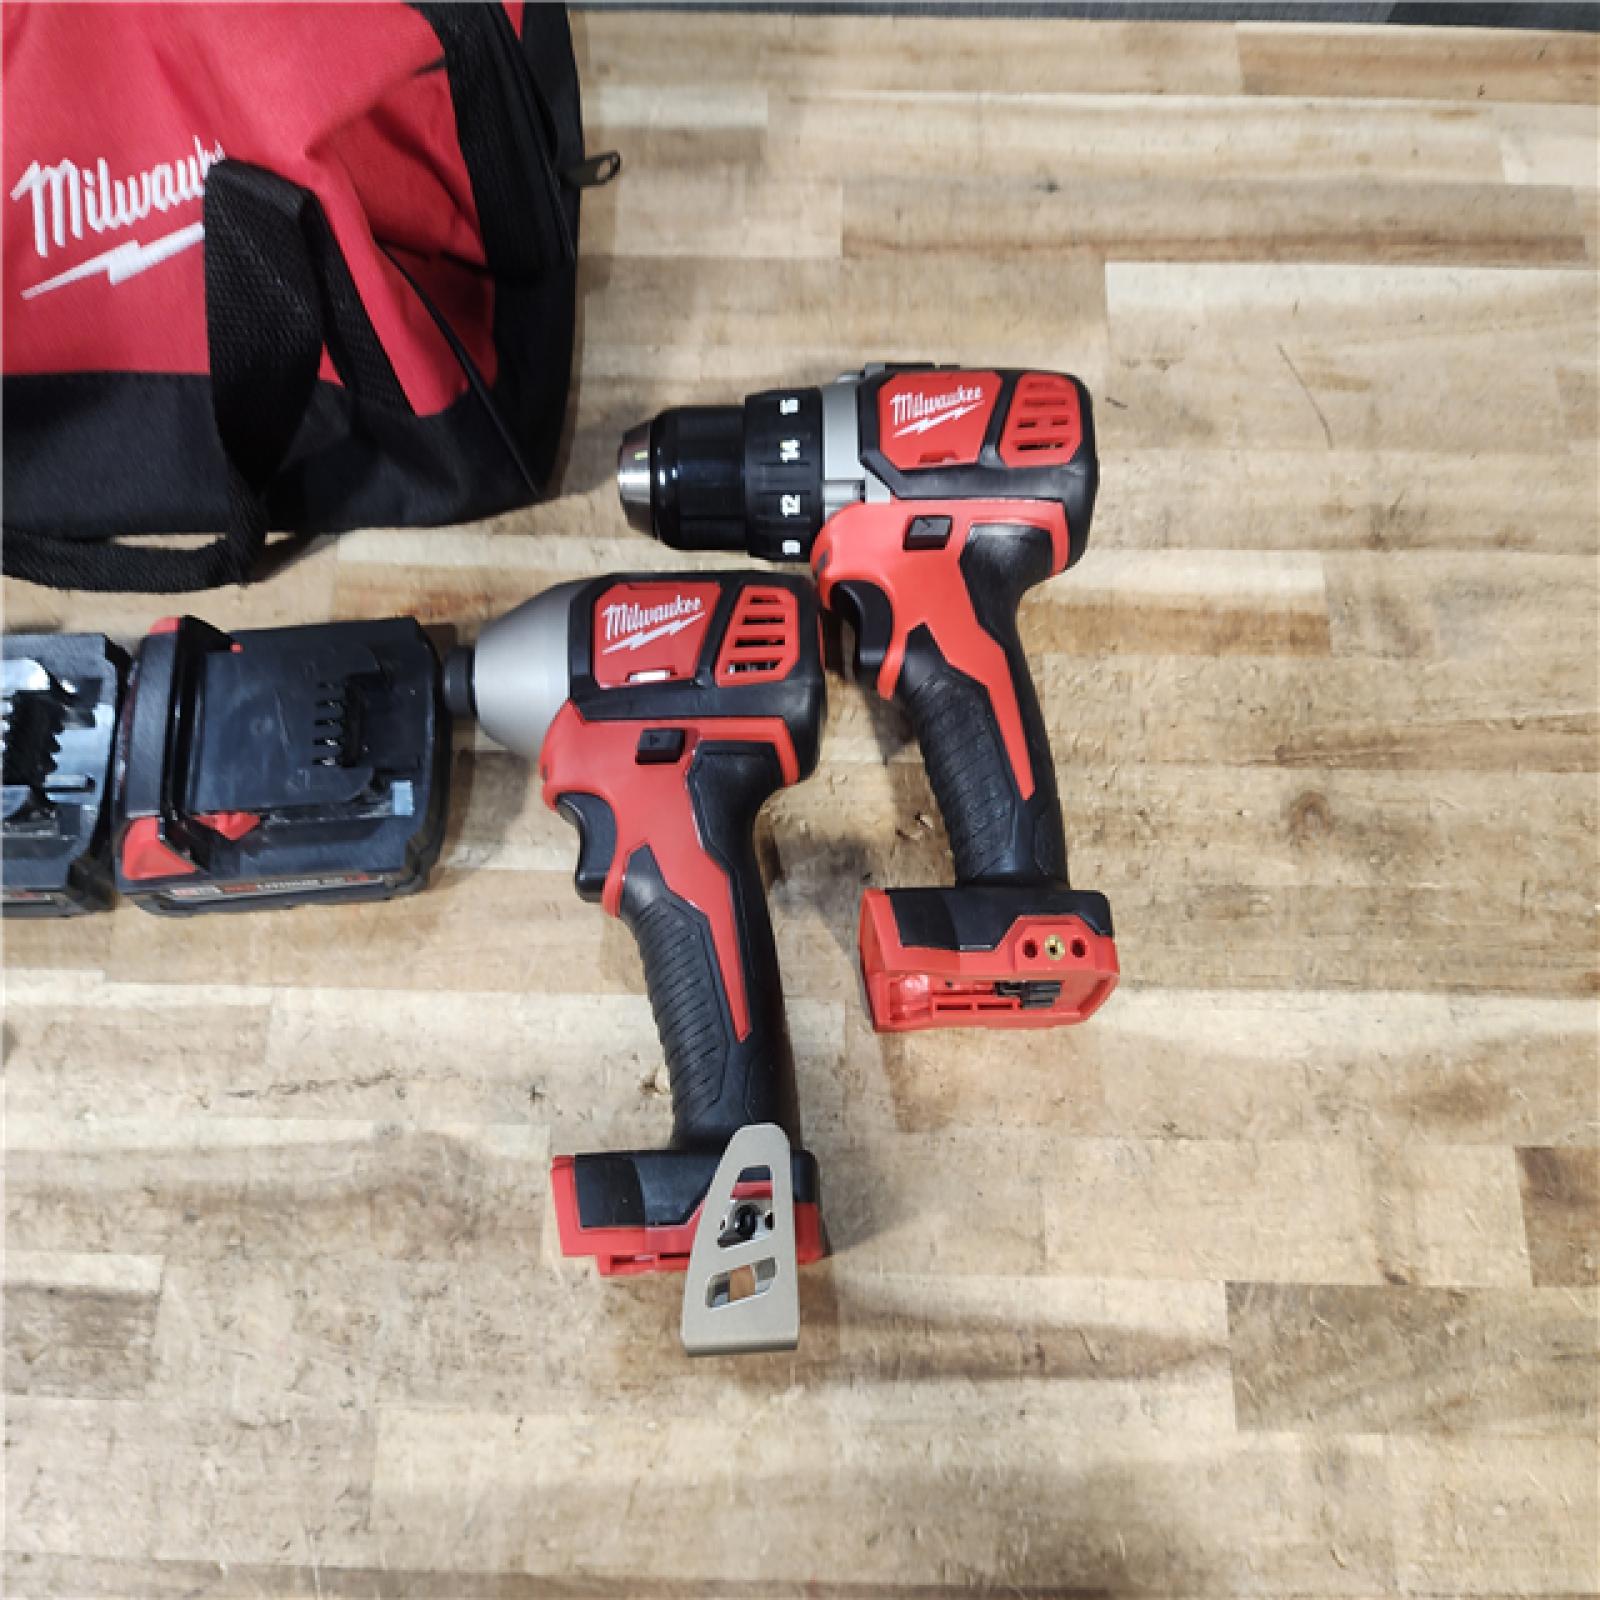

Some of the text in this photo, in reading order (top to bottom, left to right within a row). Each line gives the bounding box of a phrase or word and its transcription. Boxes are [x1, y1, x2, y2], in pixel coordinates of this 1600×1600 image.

[889, 384, 982, 425] Milwaukee
[779, 494, 801, 518] 12
[602, 594, 702, 641] Milwaukee
